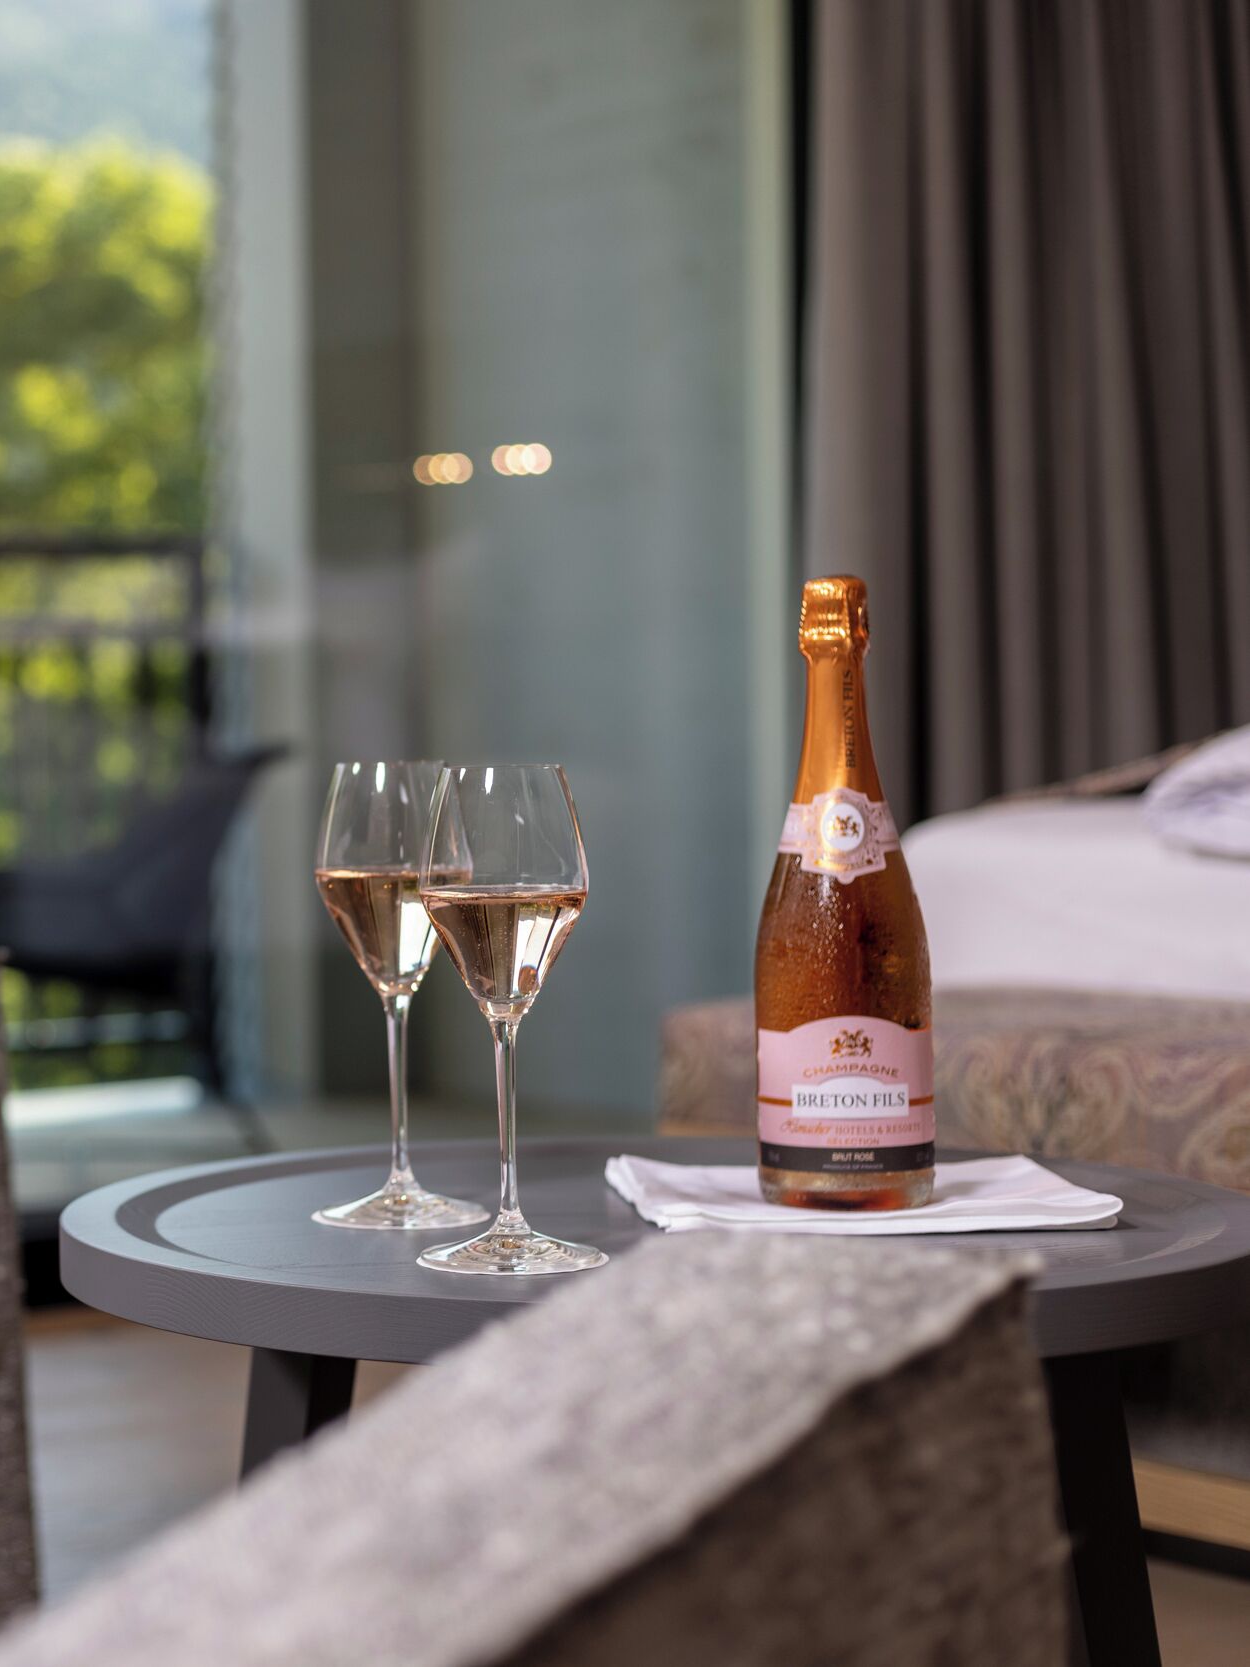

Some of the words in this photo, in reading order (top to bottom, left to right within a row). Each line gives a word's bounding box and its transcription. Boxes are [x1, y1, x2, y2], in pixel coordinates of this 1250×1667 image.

[803, 1063, 900, 1079] CHAMPAGNE
[796, 1092, 868, 1108] BRETON
[872, 1090, 906, 1107] FILS
[835, 1124, 875, 1136] HOTELS
[832, 1151, 853, 1162] BRUT
